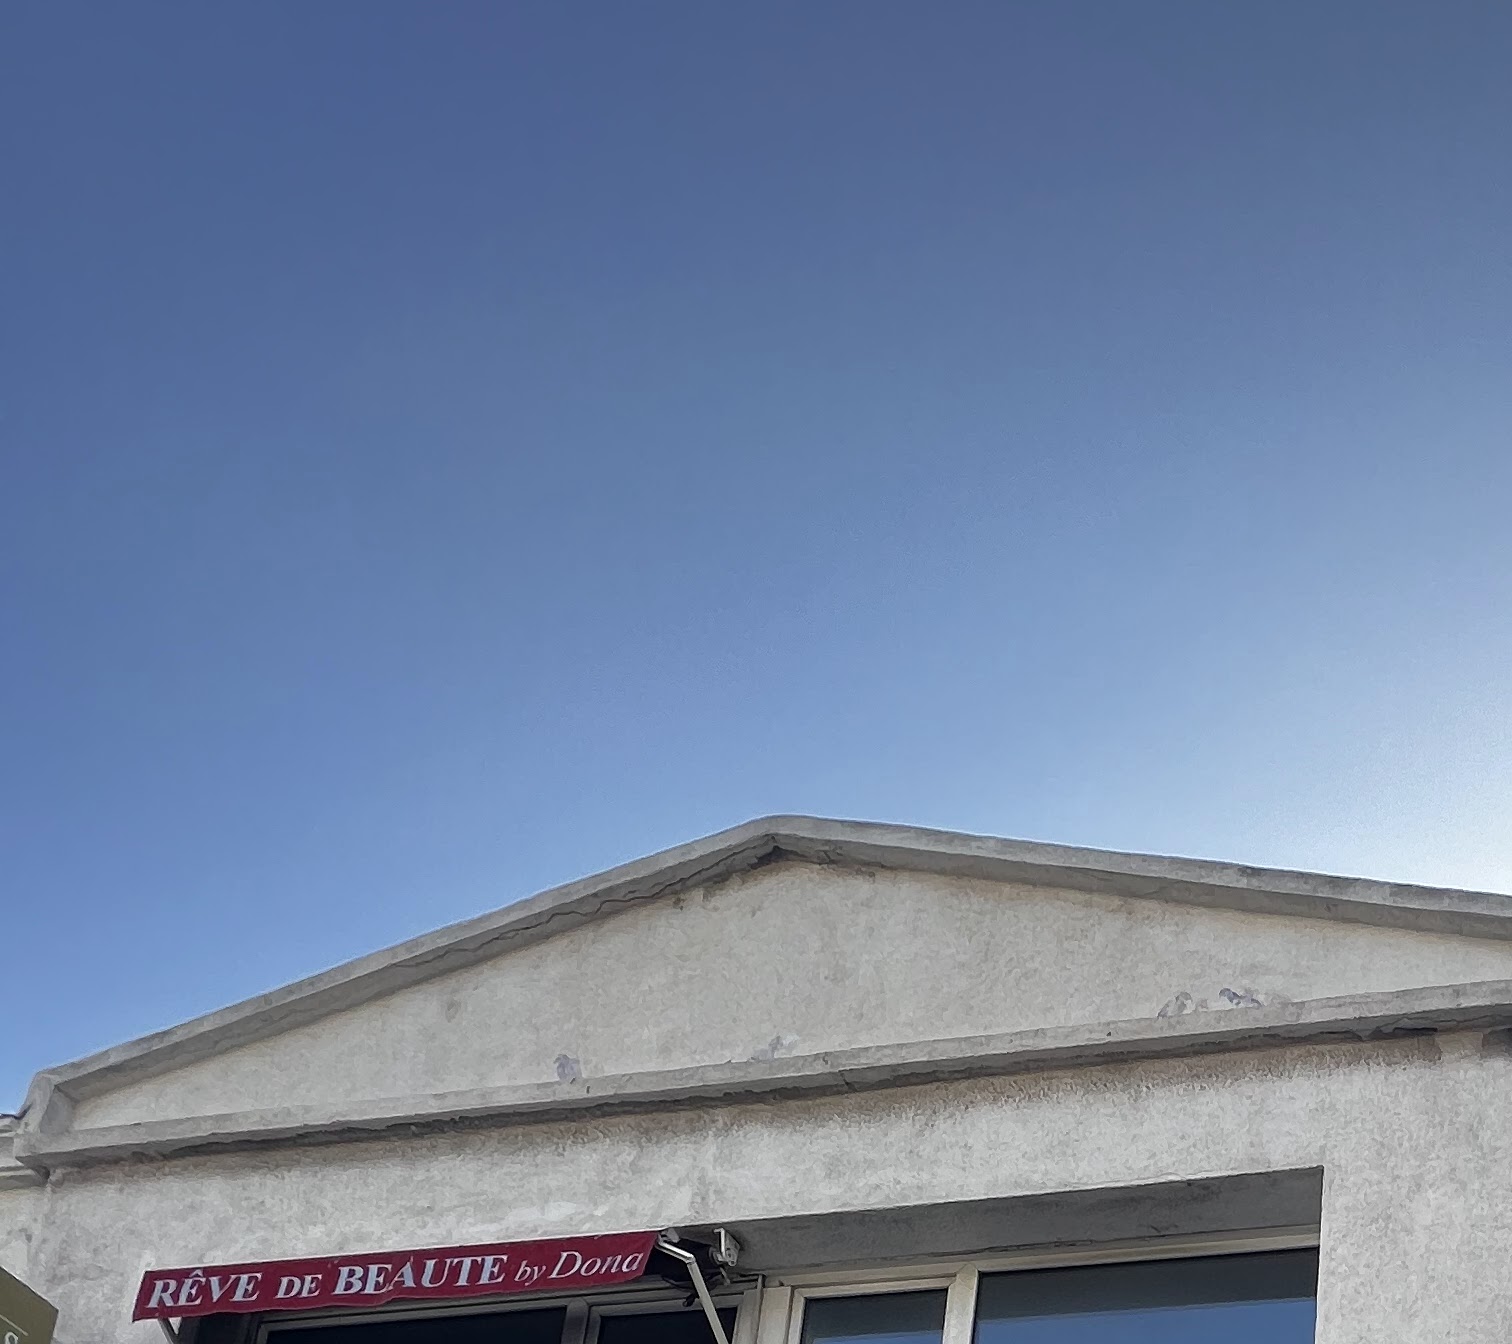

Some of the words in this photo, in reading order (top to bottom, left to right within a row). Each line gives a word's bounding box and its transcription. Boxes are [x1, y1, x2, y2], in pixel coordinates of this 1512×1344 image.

[147, 1269, 263, 1309] RÊVE
[275, 1274, 322, 1300] DE
[331, 1254, 509, 1297] BEAUTE
[514, 1259, 546, 1286] by
[547, 1250, 644, 1280] Dona
